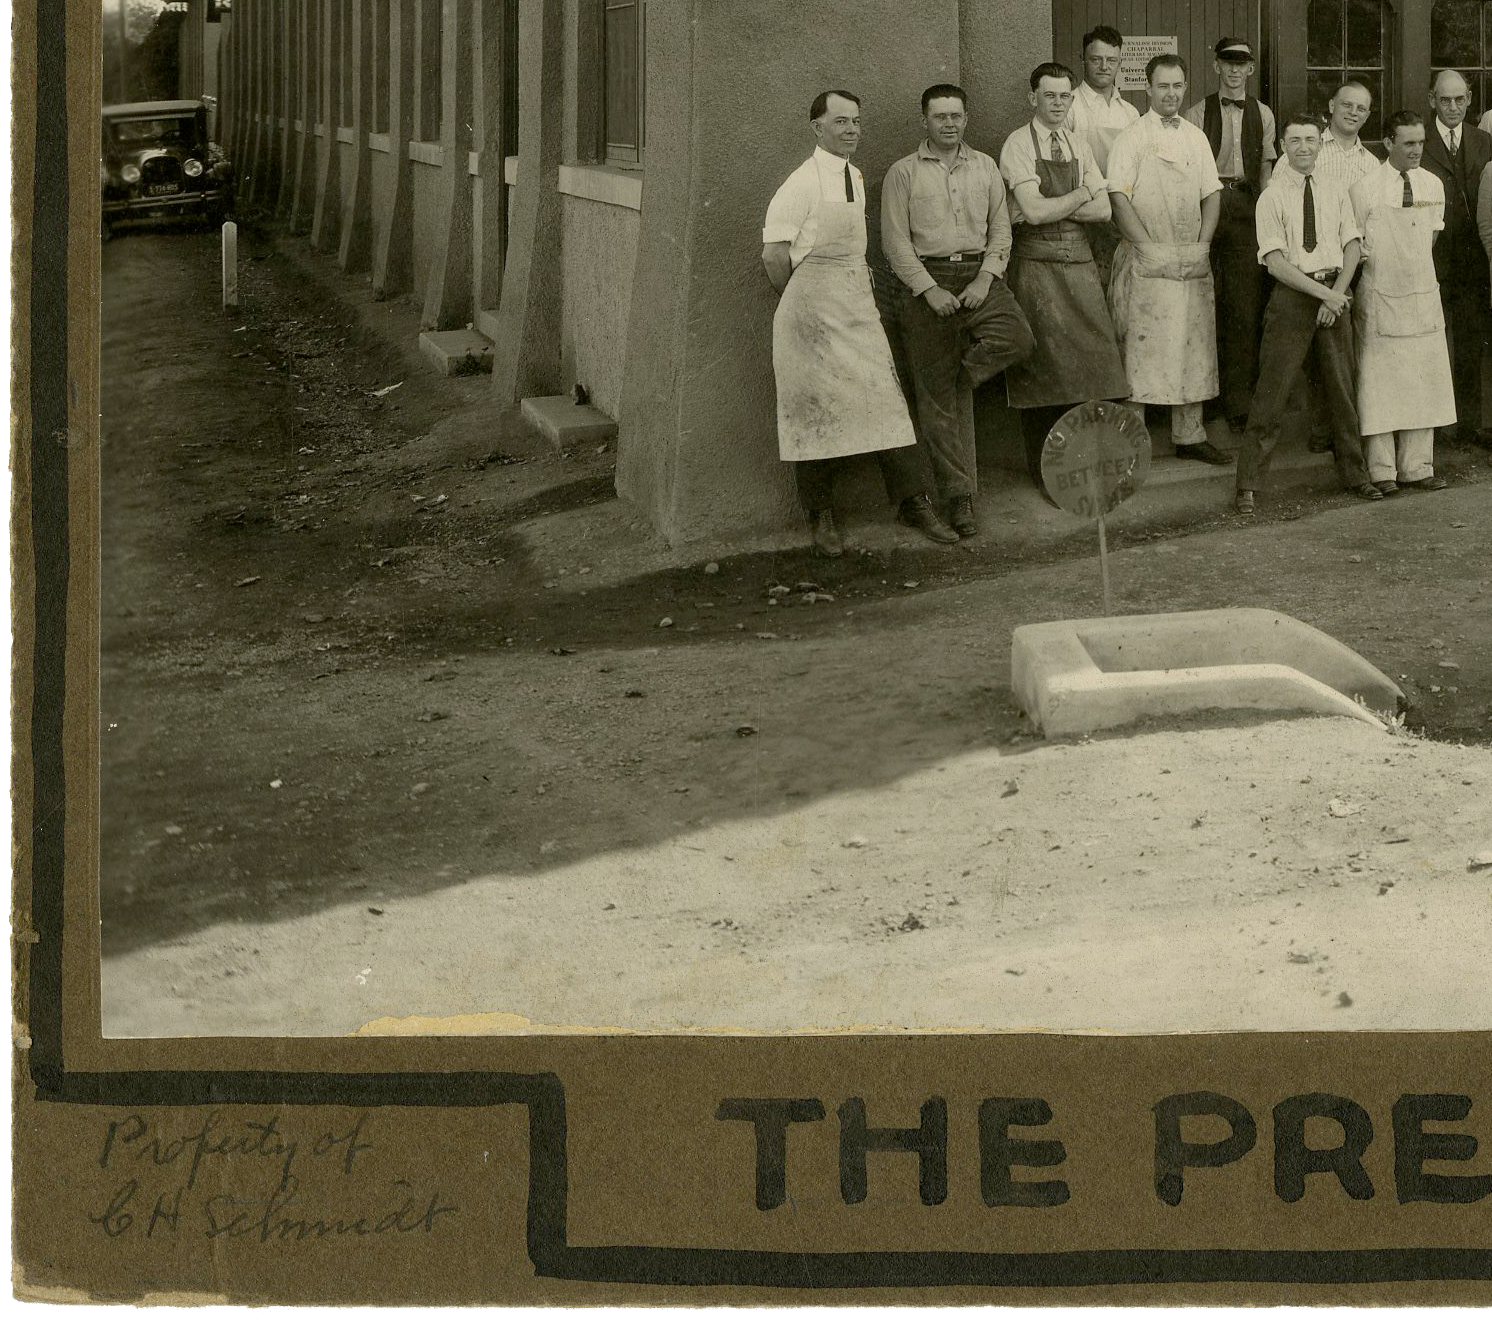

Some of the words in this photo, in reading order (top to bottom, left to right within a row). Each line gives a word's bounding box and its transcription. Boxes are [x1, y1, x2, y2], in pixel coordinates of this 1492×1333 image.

[1044, 431, 1067, 468] NO
[1056, 454, 1140, 491] BETWEEN
[98, 1109, 298, 1192] Property
[313, 1112, 376, 1174] of
[718, 1097, 1070, 1211] THE
[204, 1175, 458, 1244] Schmidt
